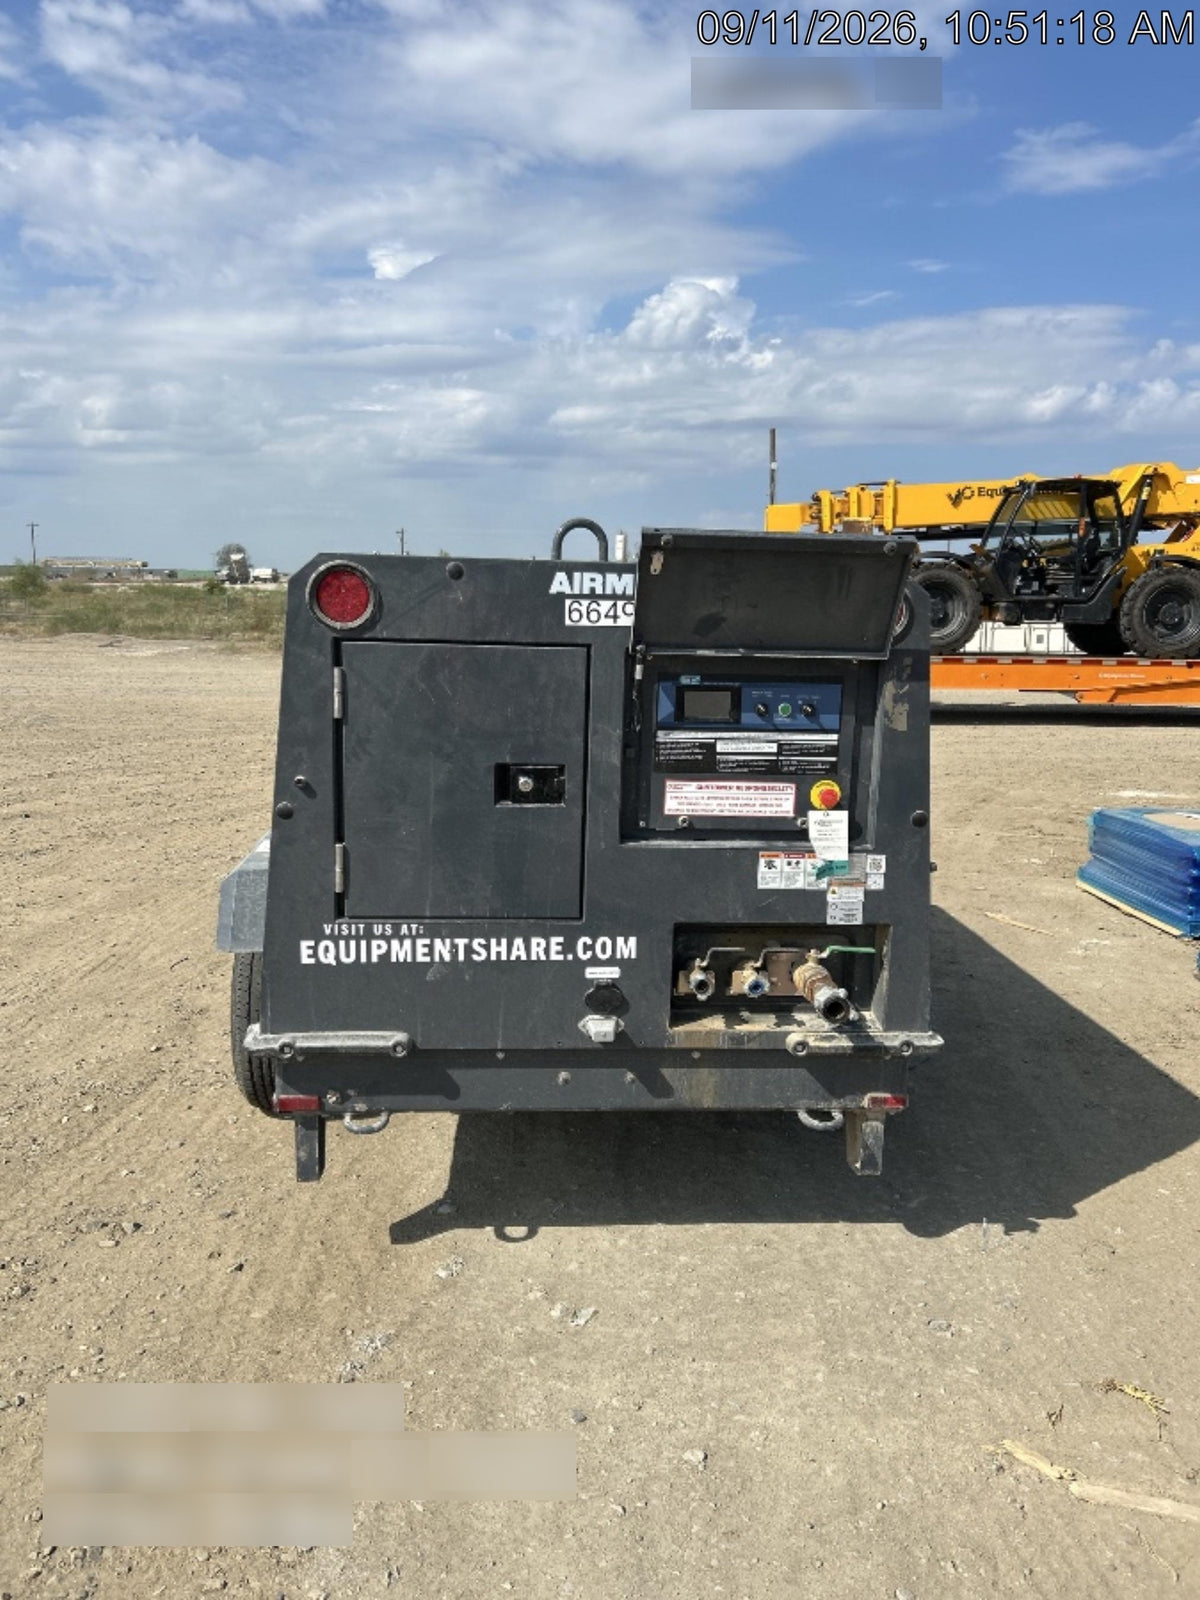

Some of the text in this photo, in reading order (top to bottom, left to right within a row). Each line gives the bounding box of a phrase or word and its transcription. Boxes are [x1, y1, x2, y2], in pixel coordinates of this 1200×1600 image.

[323, 924, 424, 936] VISIT US AT:
[300, 936, 638, 966] EQUIPMENTSHARE.COM
